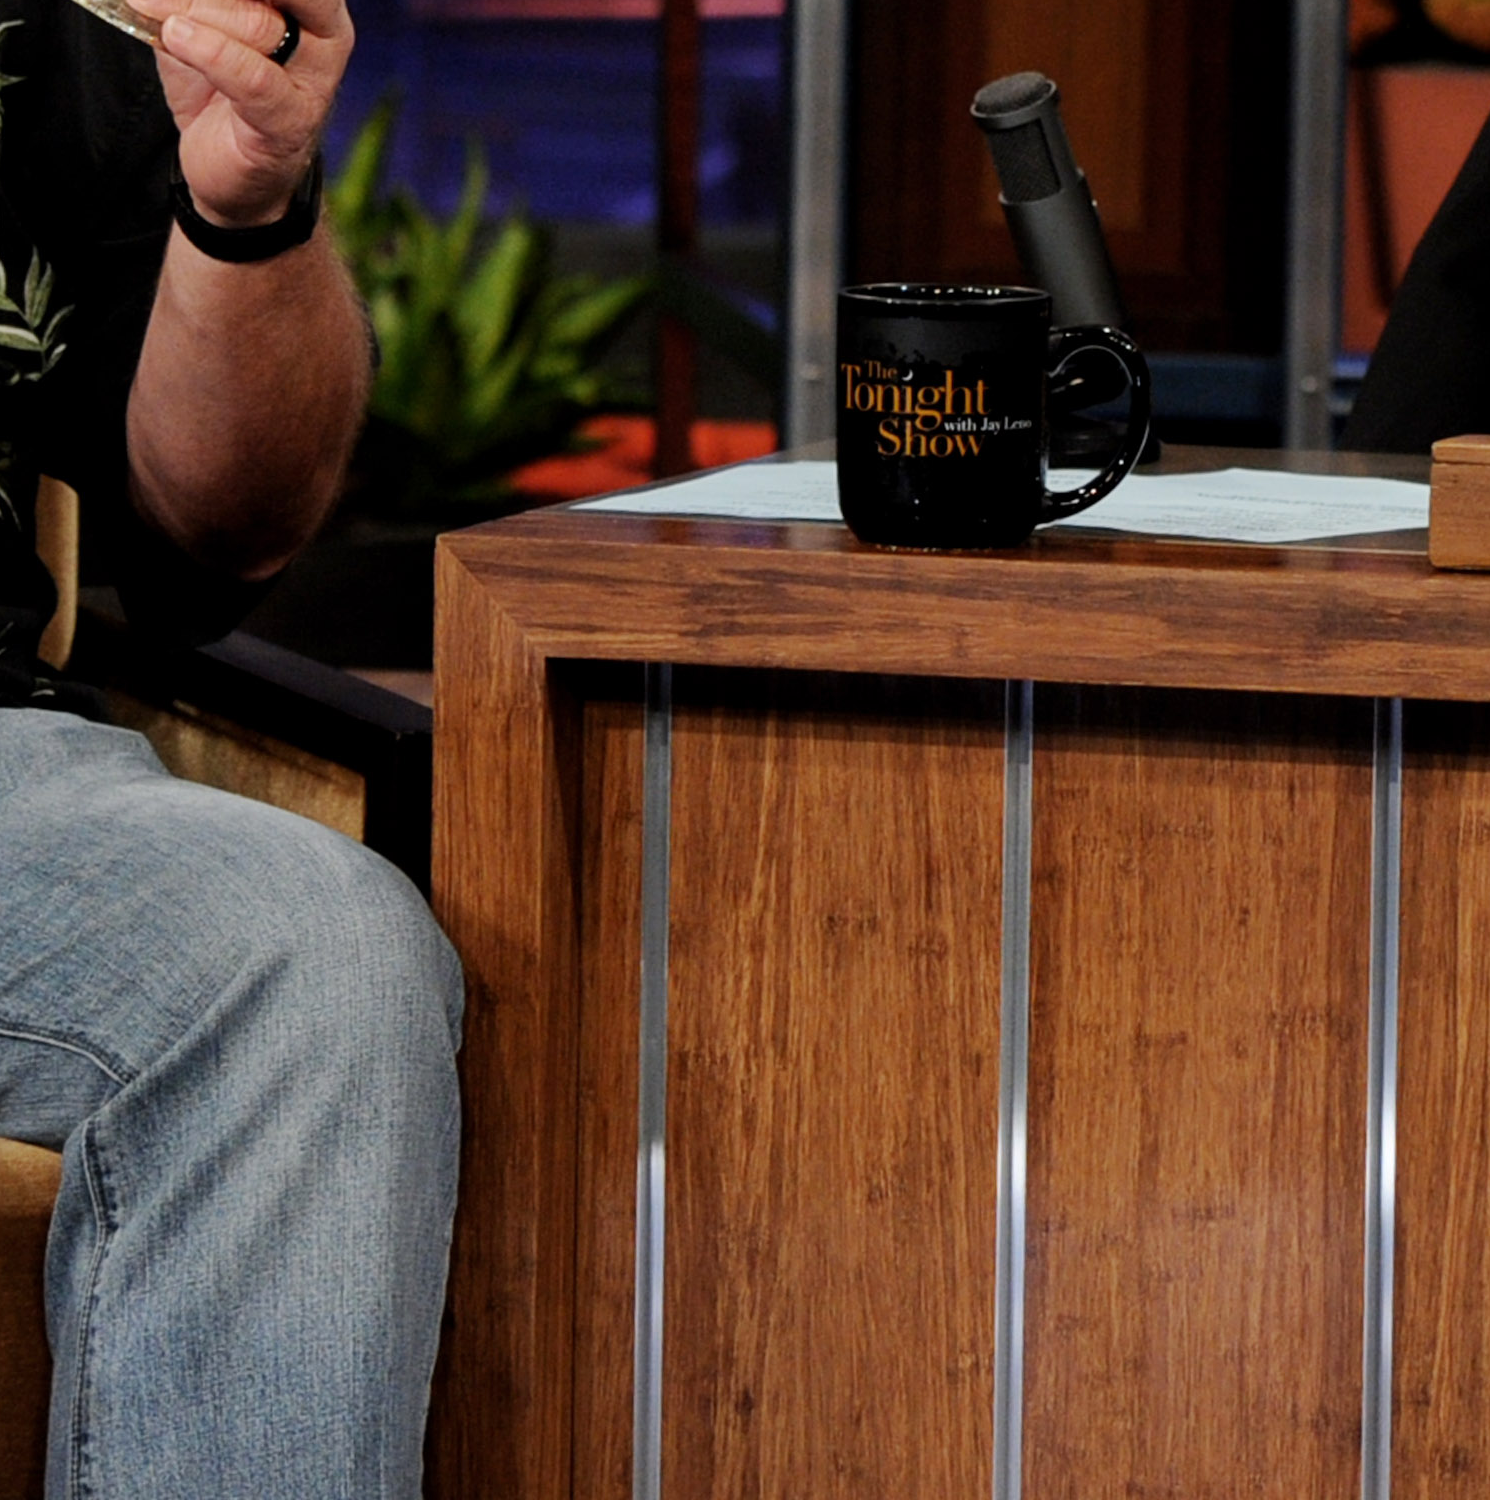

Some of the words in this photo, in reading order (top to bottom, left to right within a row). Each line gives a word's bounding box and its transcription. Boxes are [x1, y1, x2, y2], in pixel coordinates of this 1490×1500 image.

[864, 360, 898, 380] The
[841, 362, 991, 431] Tonight
[876, 416, 986, 458] Show
[944, 417, 977, 432] with
[980, 417, 1002, 436] Jay
[1004, 416, 1032, 431] Leno
